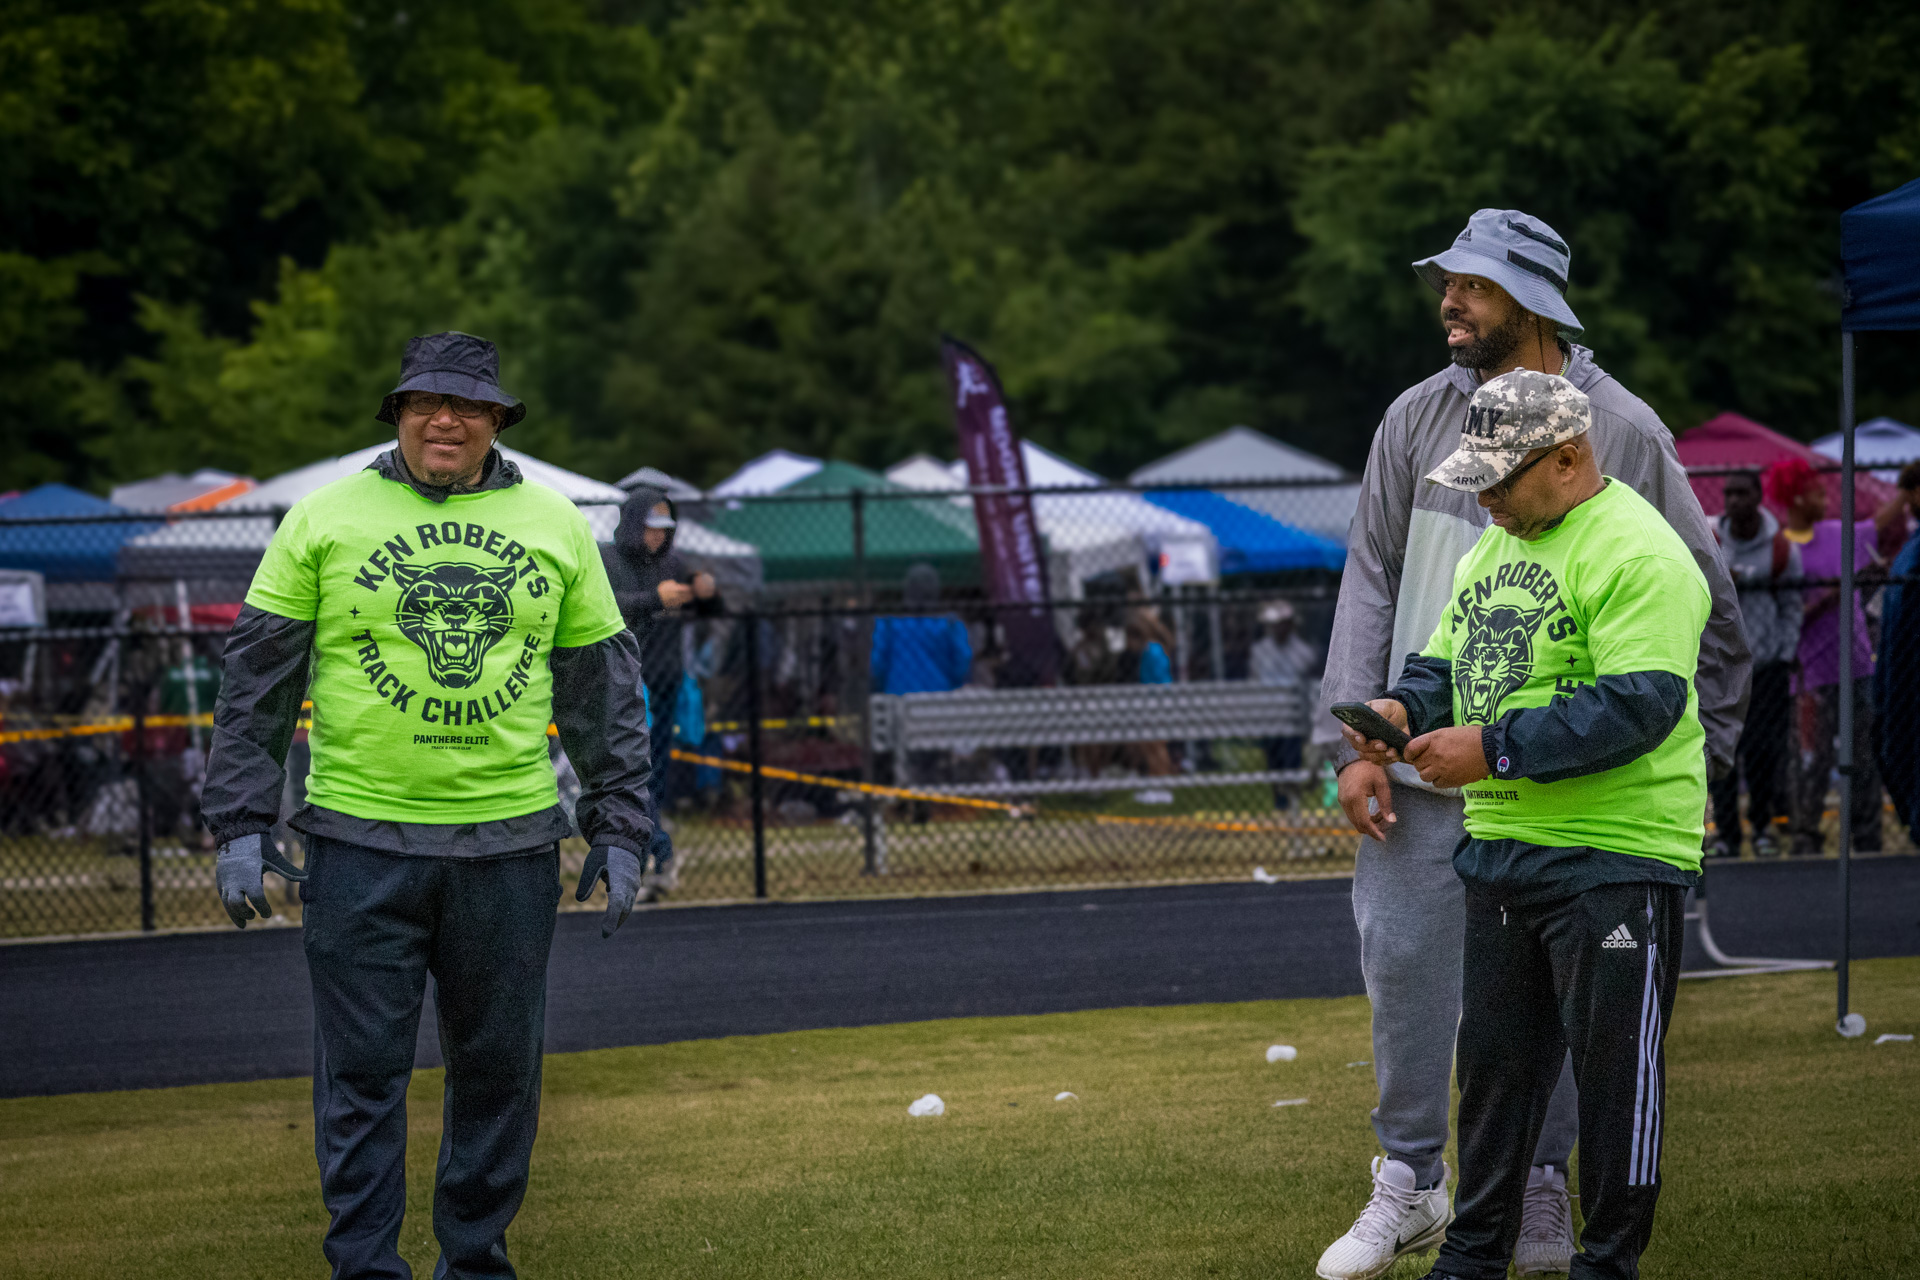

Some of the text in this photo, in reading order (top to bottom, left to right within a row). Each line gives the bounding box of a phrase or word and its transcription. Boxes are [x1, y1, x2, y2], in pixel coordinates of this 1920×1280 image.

[1453, 474, 1486, 485] ARMY
[353, 521, 549, 599] KEN ROBERTS
[1493, 560, 1578, 642] ROBERTS
[351, 629, 541, 726] TRACK CHALLENGE
[413, 734, 490, 745] PANTHERS ELITE
[1494, 790, 1520, 801] ELITE
[1602, 939, 1638, 949] adidas
